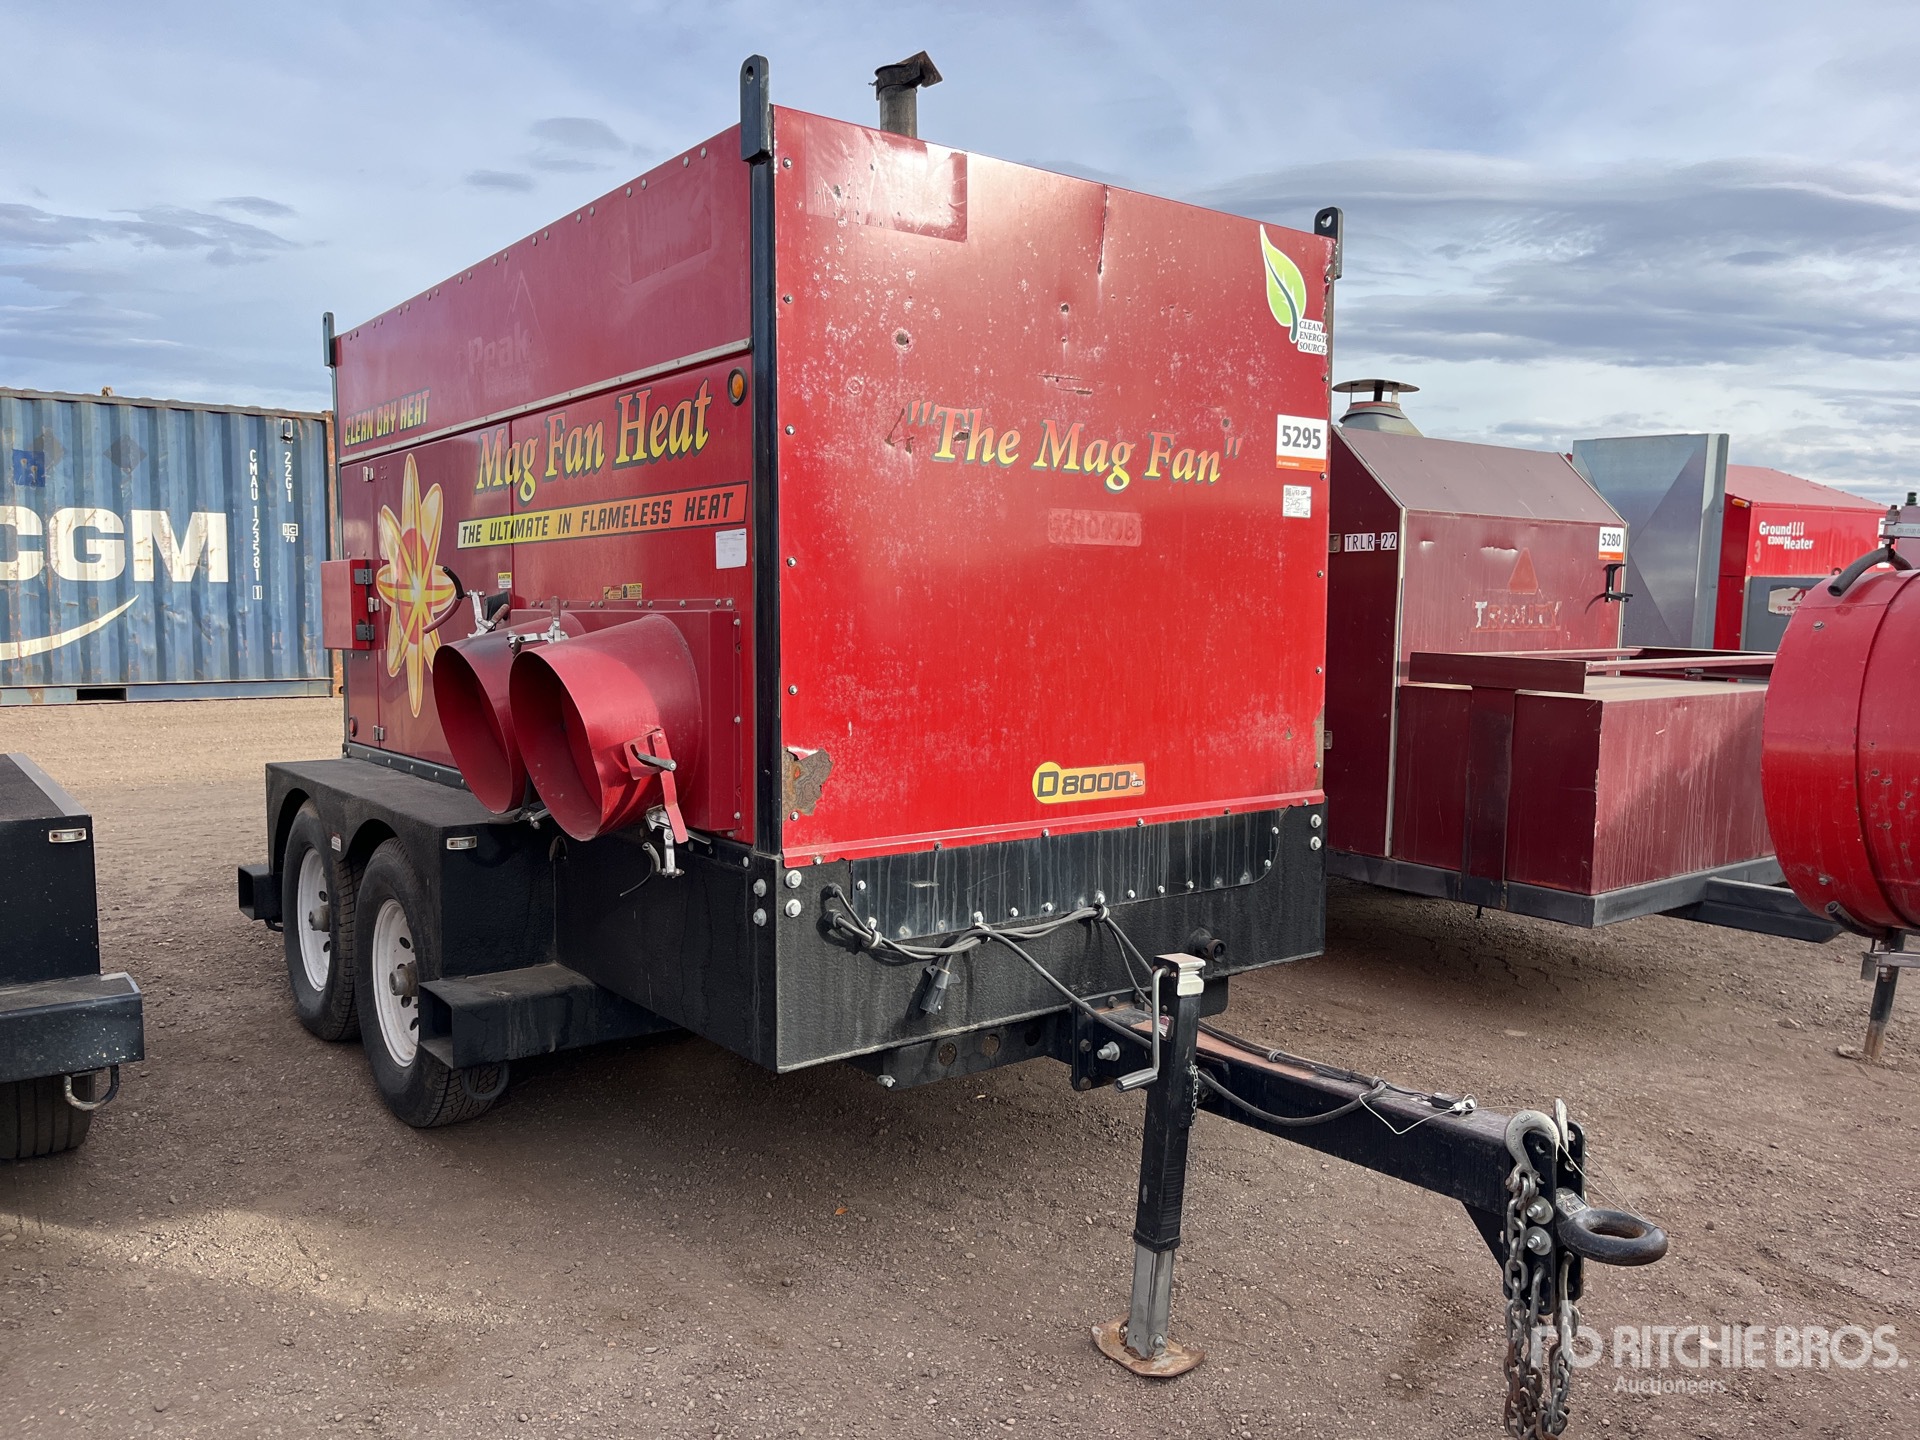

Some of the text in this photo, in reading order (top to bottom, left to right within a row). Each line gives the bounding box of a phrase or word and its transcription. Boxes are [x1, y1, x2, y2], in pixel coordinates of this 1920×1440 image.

[1300, 321, 1321, 332] CLEAN
[1300, 331, 1327, 342] ENERGY
[1299, 342, 1326, 353] SOURCE
[344, 408, 374, 447] CLEAN
[400, 389, 430, 430] HEAT
[475, 379, 713, 503] Mag Fan Heat
[1282, 425, 1321, 449] 5295
[1033, 419, 1136, 491] Mag
[250, 449, 259, 501] CMAU
[284, 451, 293, 502] 22G1
[462, 492, 734, 544] THE ULTIMATE IN FLAMELESS HEAT
[1759, 521, 1793, 536] Ground
[252, 505, 260, 581] 123581
[1601, 532, 1621, 547] 5280
[1753, 539, 1762, 563] 3
[1784, 536, 1814, 550] Heater
